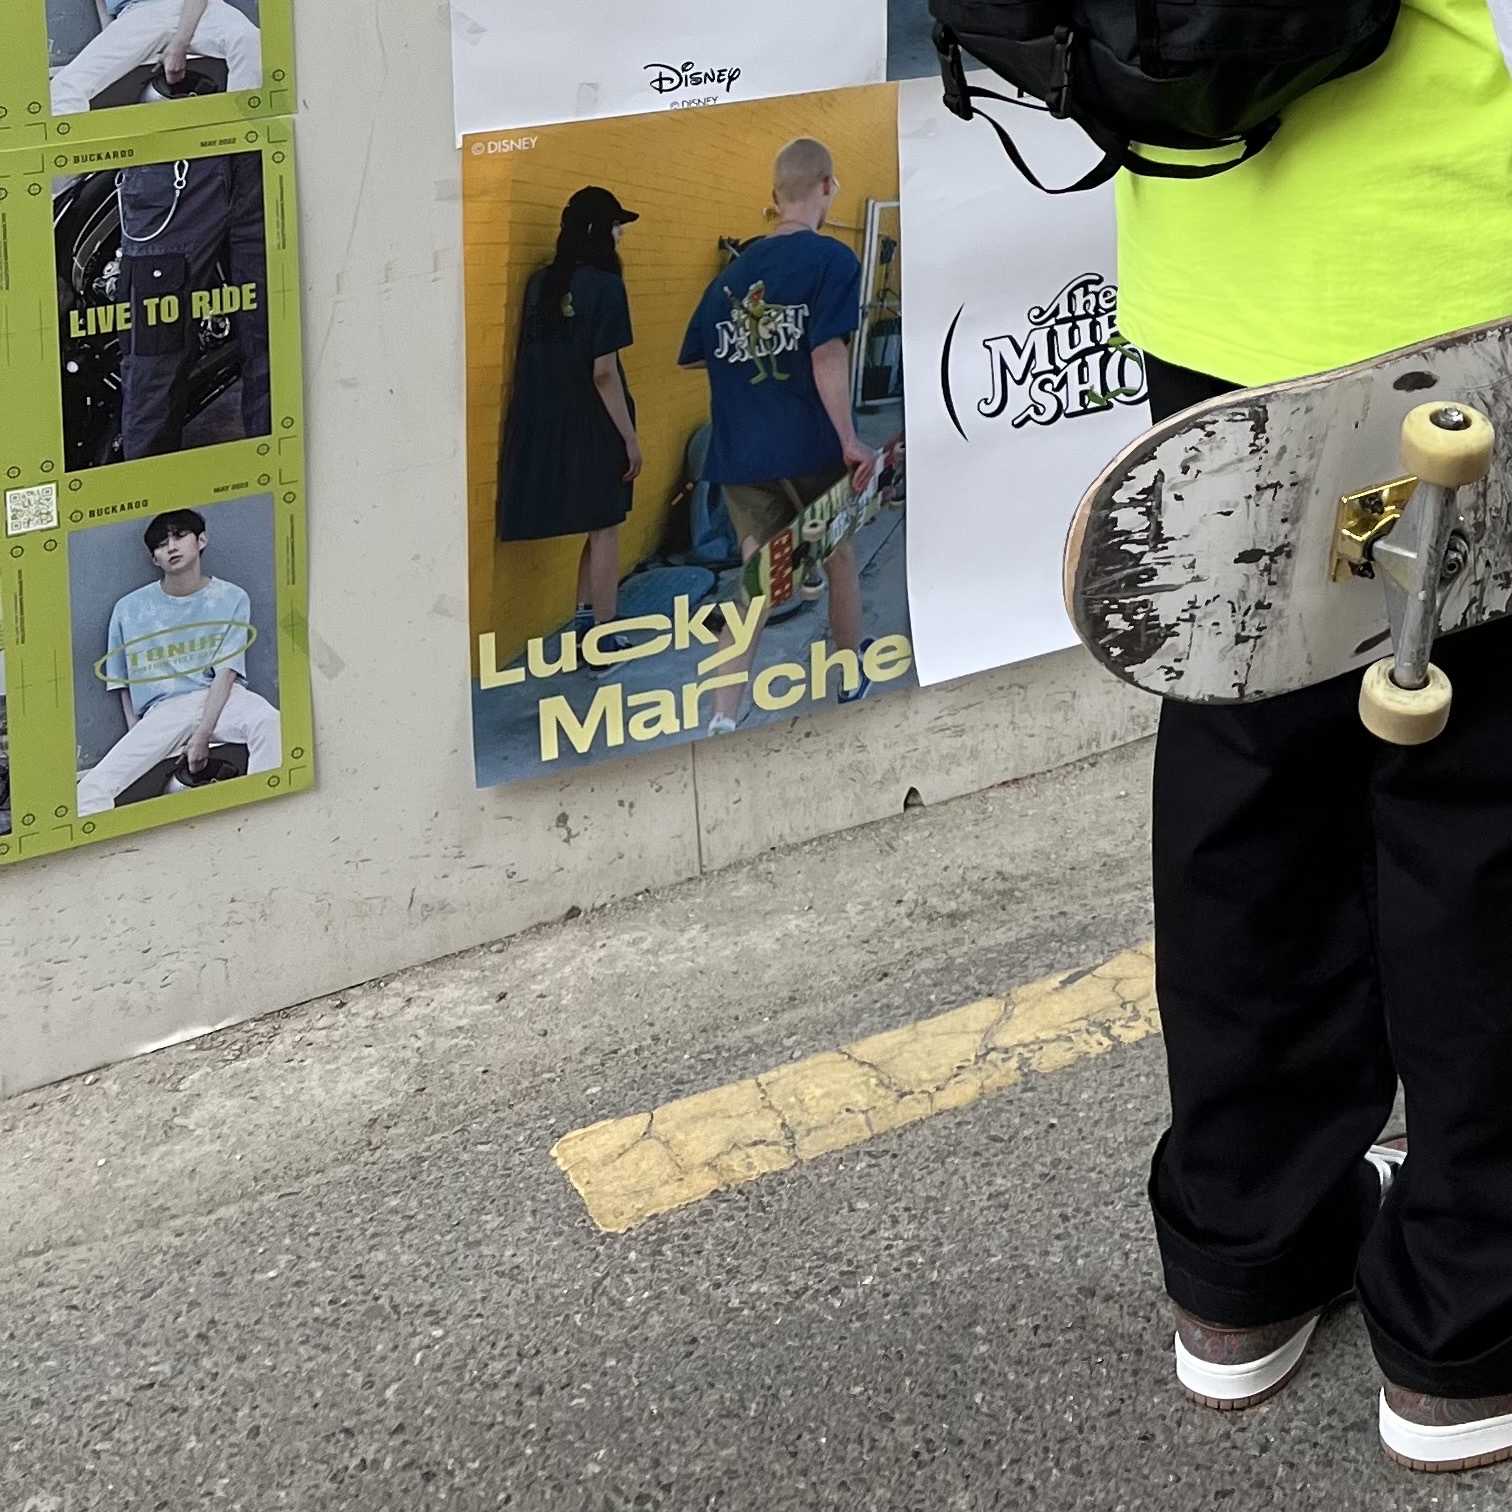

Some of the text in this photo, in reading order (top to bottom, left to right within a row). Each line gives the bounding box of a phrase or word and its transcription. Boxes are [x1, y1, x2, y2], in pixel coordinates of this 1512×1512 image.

[69, 283, 258, 338] LIVE TO RIDE
[1028, 273, 1118, 326] The
[977, 312, 1119, 418] MUP
[1011, 343, 1149, 428] SHO
[479, 594, 765, 691] Lucky
[538, 631, 913, 762] Marche
